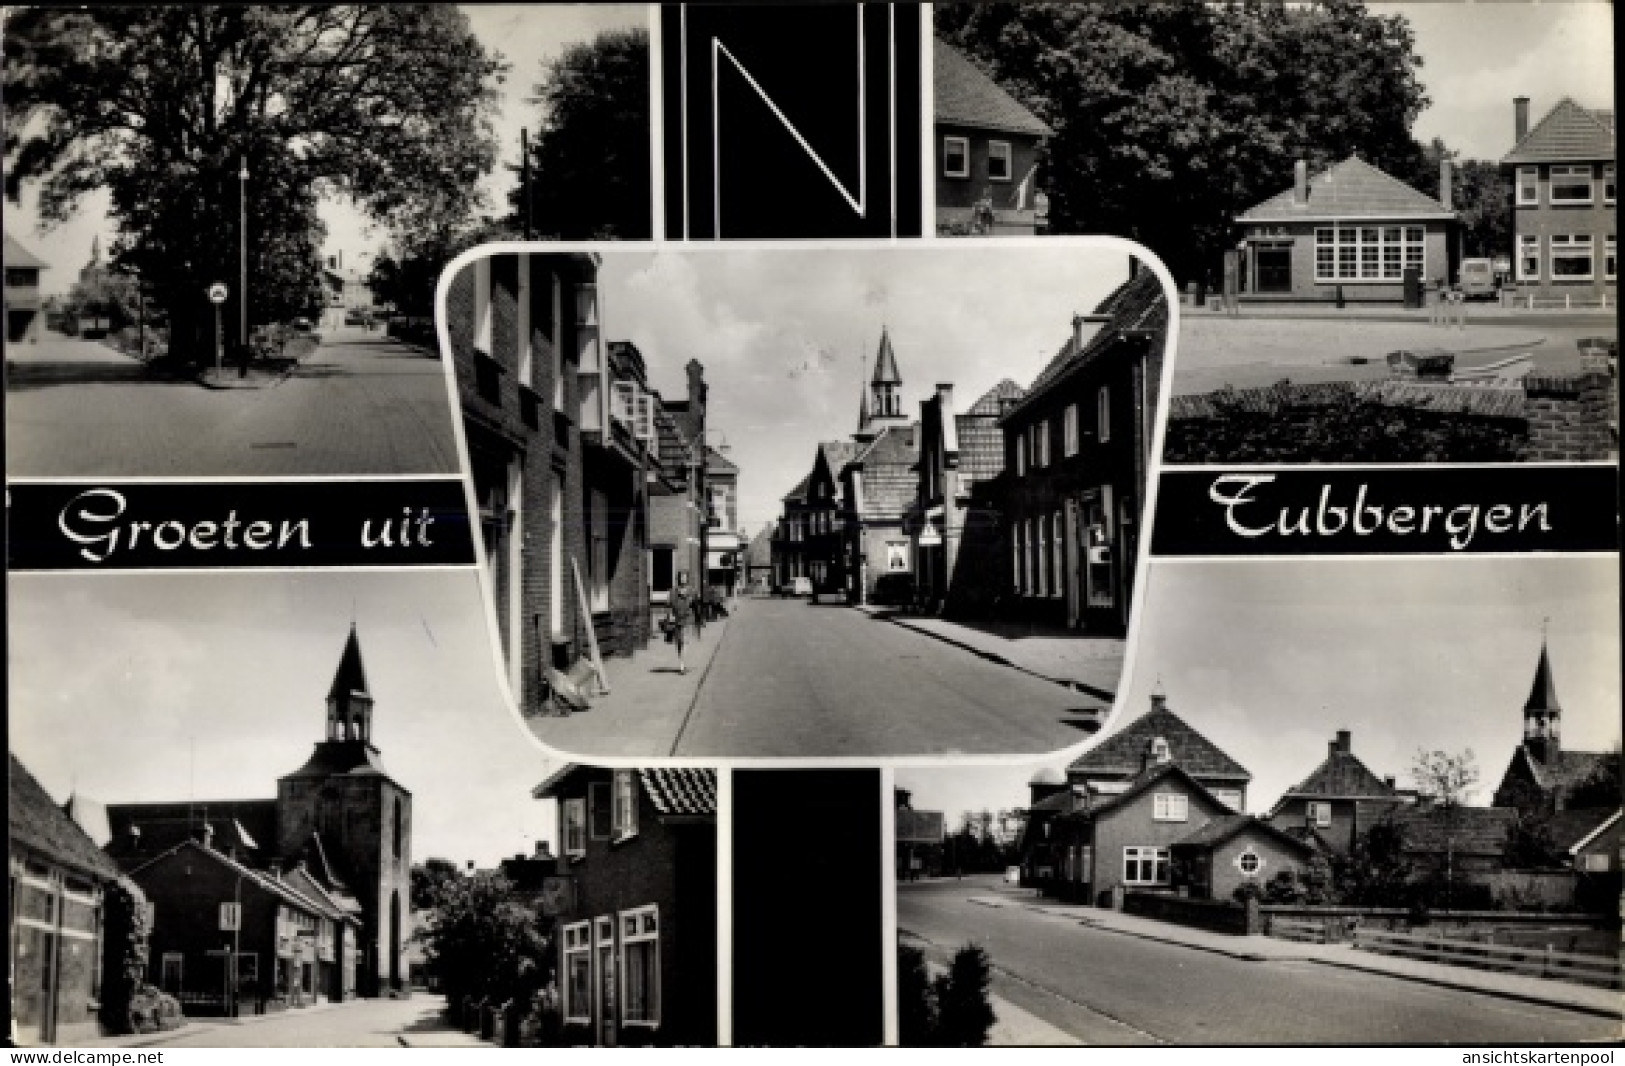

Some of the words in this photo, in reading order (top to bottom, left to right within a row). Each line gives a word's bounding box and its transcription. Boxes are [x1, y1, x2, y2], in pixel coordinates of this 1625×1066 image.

[59, 488, 311, 561] Groeten
[361, 507, 434, 547] uit
[1210, 474, 1552, 549] Tubbergen
